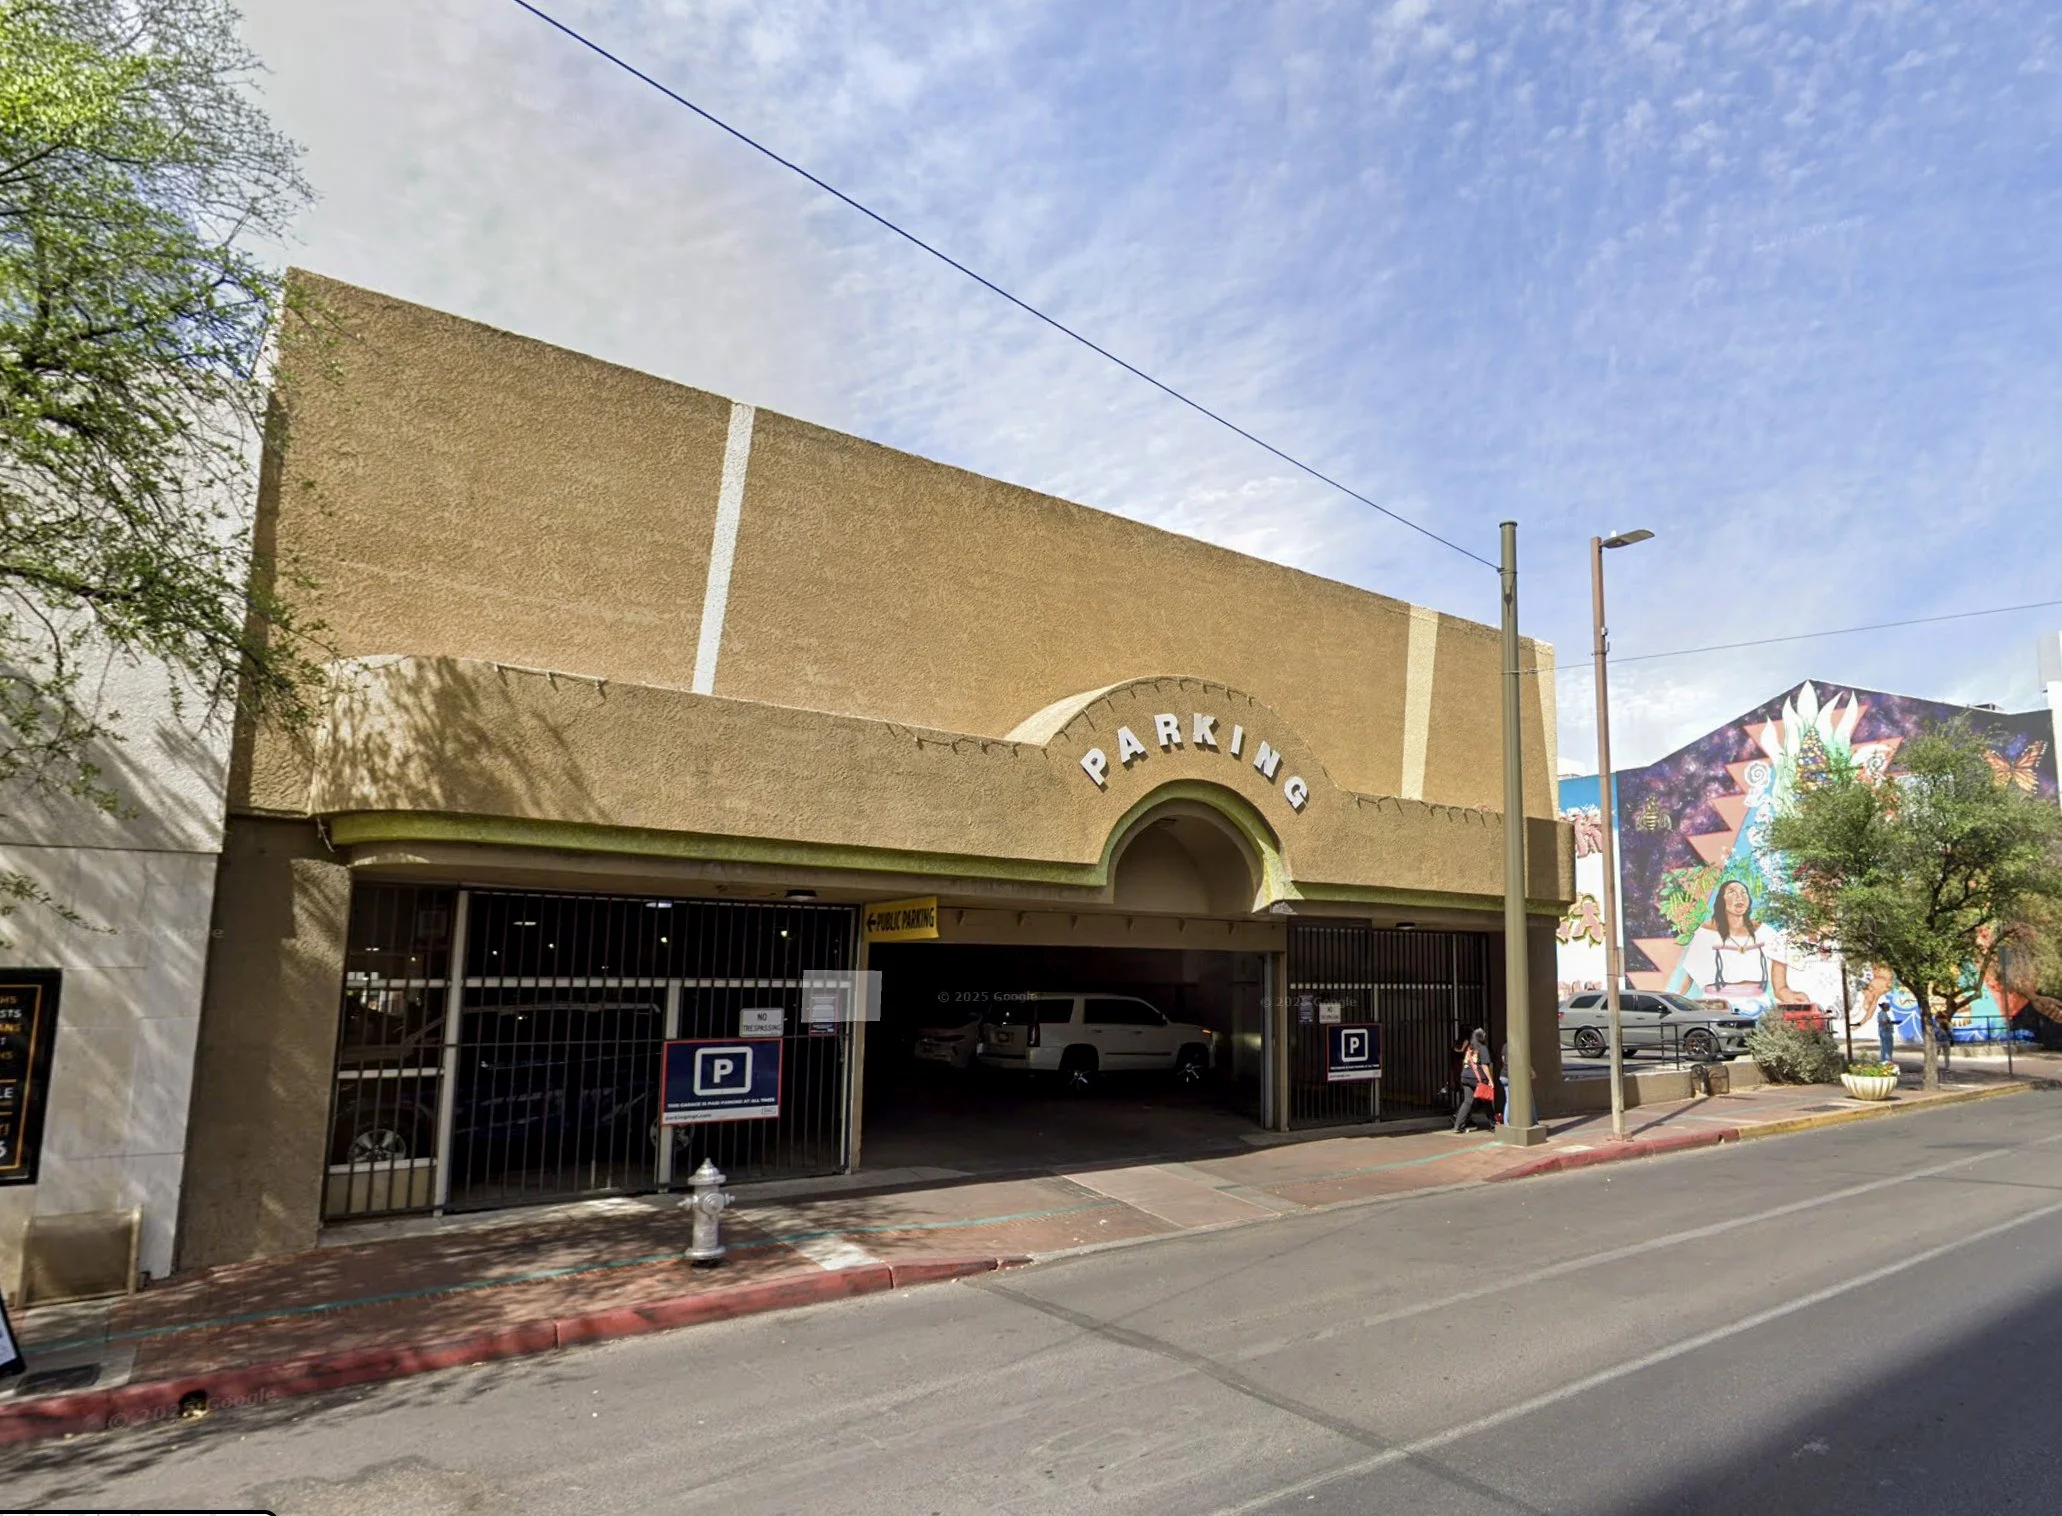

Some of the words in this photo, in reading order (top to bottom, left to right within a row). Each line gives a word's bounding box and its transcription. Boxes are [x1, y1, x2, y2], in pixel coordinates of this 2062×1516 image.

[1080, 713, 1308, 810] PARKING
[877, 910, 901, 931] PUBLIC
[902, 907, 935, 929] PARKING
[757, 1012, 767, 1021] NO
[1349, 1037, 1360, 1054] P
[713, 1059, 734, 1083] P
